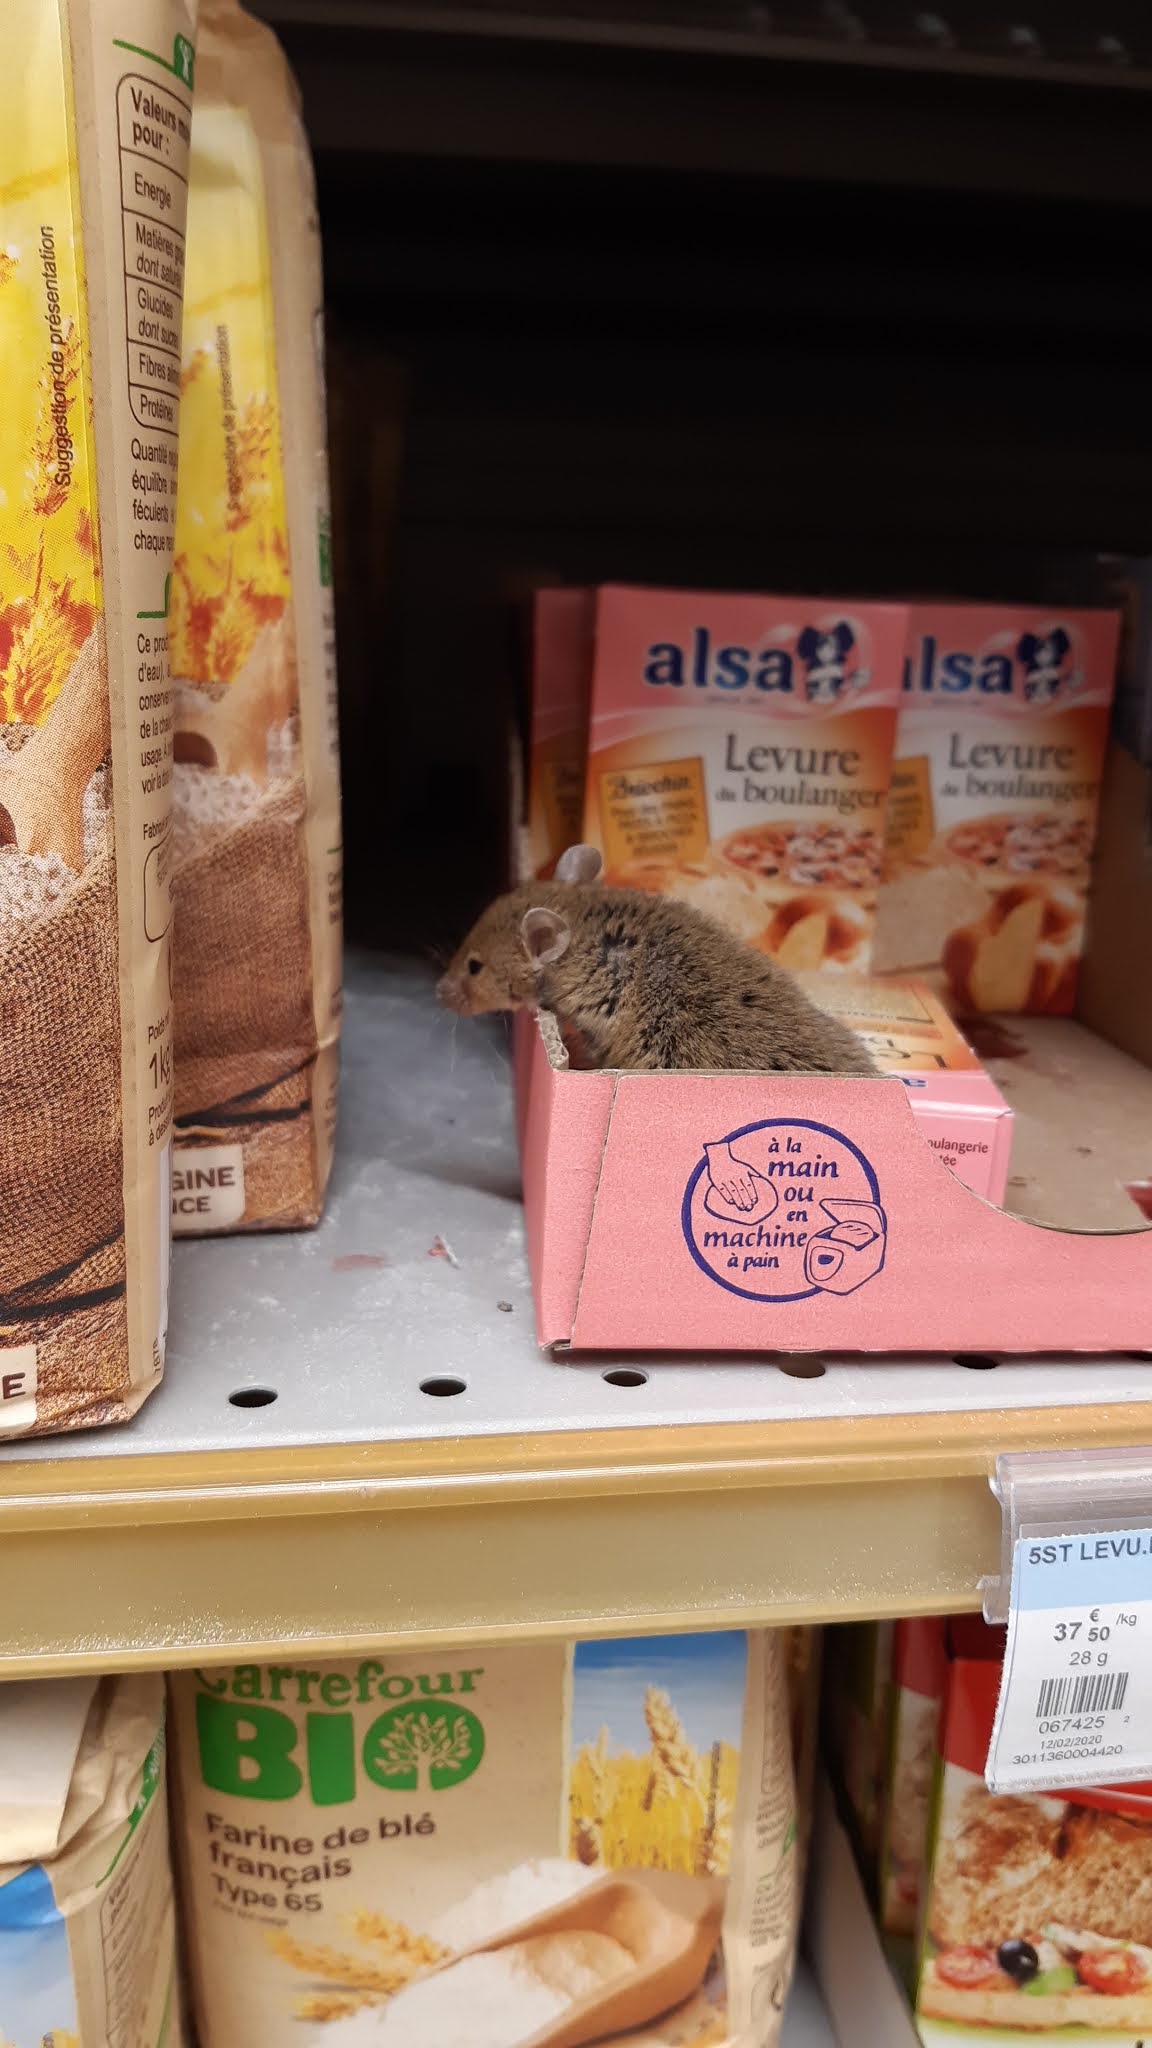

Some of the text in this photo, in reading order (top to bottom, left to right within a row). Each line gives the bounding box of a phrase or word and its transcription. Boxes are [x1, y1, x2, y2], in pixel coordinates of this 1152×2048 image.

[130, 86, 177, 132] Valeurs
[132, 120, 163, 152] pour
[134, 171, 172, 211] Energie
[136, 221, 173, 258] Matières
[137, 251, 159, 279] dont
[137, 287, 174, 320] Glucides
[138, 315, 160, 342] dont
[38, 225, 73, 487] Suggestion de présentation
[139, 352, 167, 380] Fibres
[140, 393, 174, 424] Protéines
[130, 437, 168, 465] Quantité
[132, 468, 168, 496] équilibre
[132, 498, 169, 523] féculents
[134, 529, 166, 556] chaque
[137, 632, 151, 654] Ce
[644, 625, 795, 693] alsa
[140, 719, 151, 740] de
[724, 732, 860, 777] Levure
[949, 732, 1075, 771] Levure
[743, 778, 885, 816] boulanger
[768, 1136, 802, 1154] à la
[767, 1154, 839, 1178] main
[783, 1186, 814, 1202] ou
[786, 1209, 808, 1223] en
[703, 1225, 808, 1248] machine
[727, 1252, 780, 1272] à pain
[1028, 1543, 1073, 1566] 5ST
[1089, 1608, 1138, 1627] € /kg
[1053, 1622, 1110, 1642] 37 50
[1069, 1650, 1108, 1667] 28 g
[1038, 1715, 1106, 1735] 067425
[195, 1692, 486, 1807] BIO
[1012, 1744, 1123, 1766] 3011360004420
[1040, 1734, 1103, 1750] 12/02/2020
[205, 1811, 436, 1856] Farine de blé
[207, 1841, 352, 1889] français
[211, 1872, 323, 1913] Type 65
